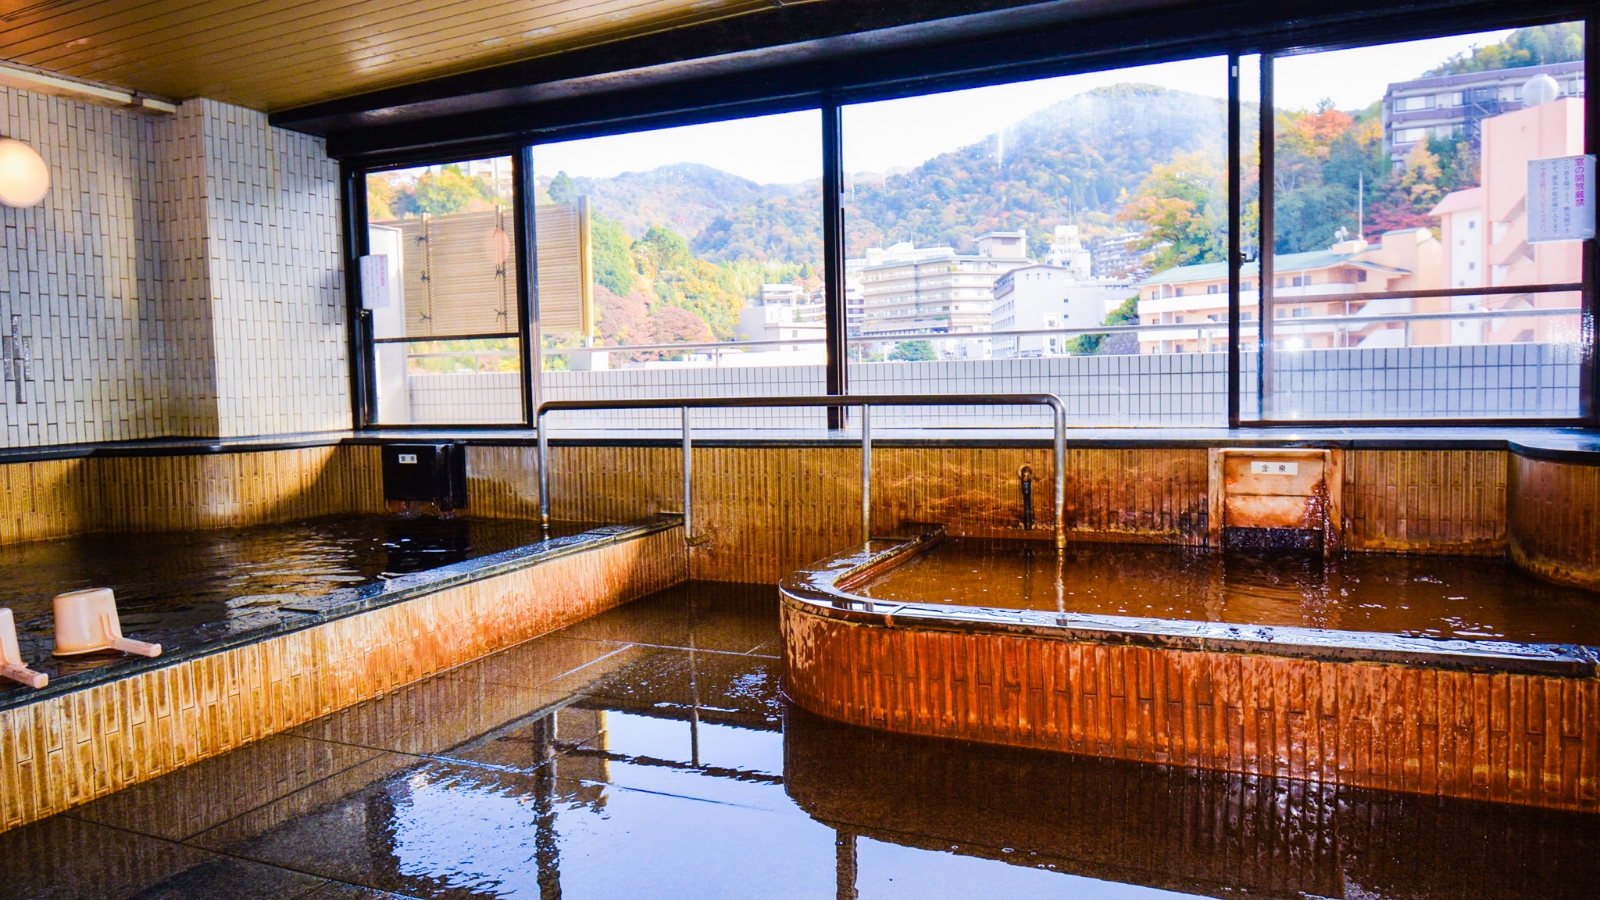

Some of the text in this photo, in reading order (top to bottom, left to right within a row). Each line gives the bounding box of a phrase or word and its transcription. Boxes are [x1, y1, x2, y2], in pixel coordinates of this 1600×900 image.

[1574, 157, 1585, 207] 窓の開放厳禁
